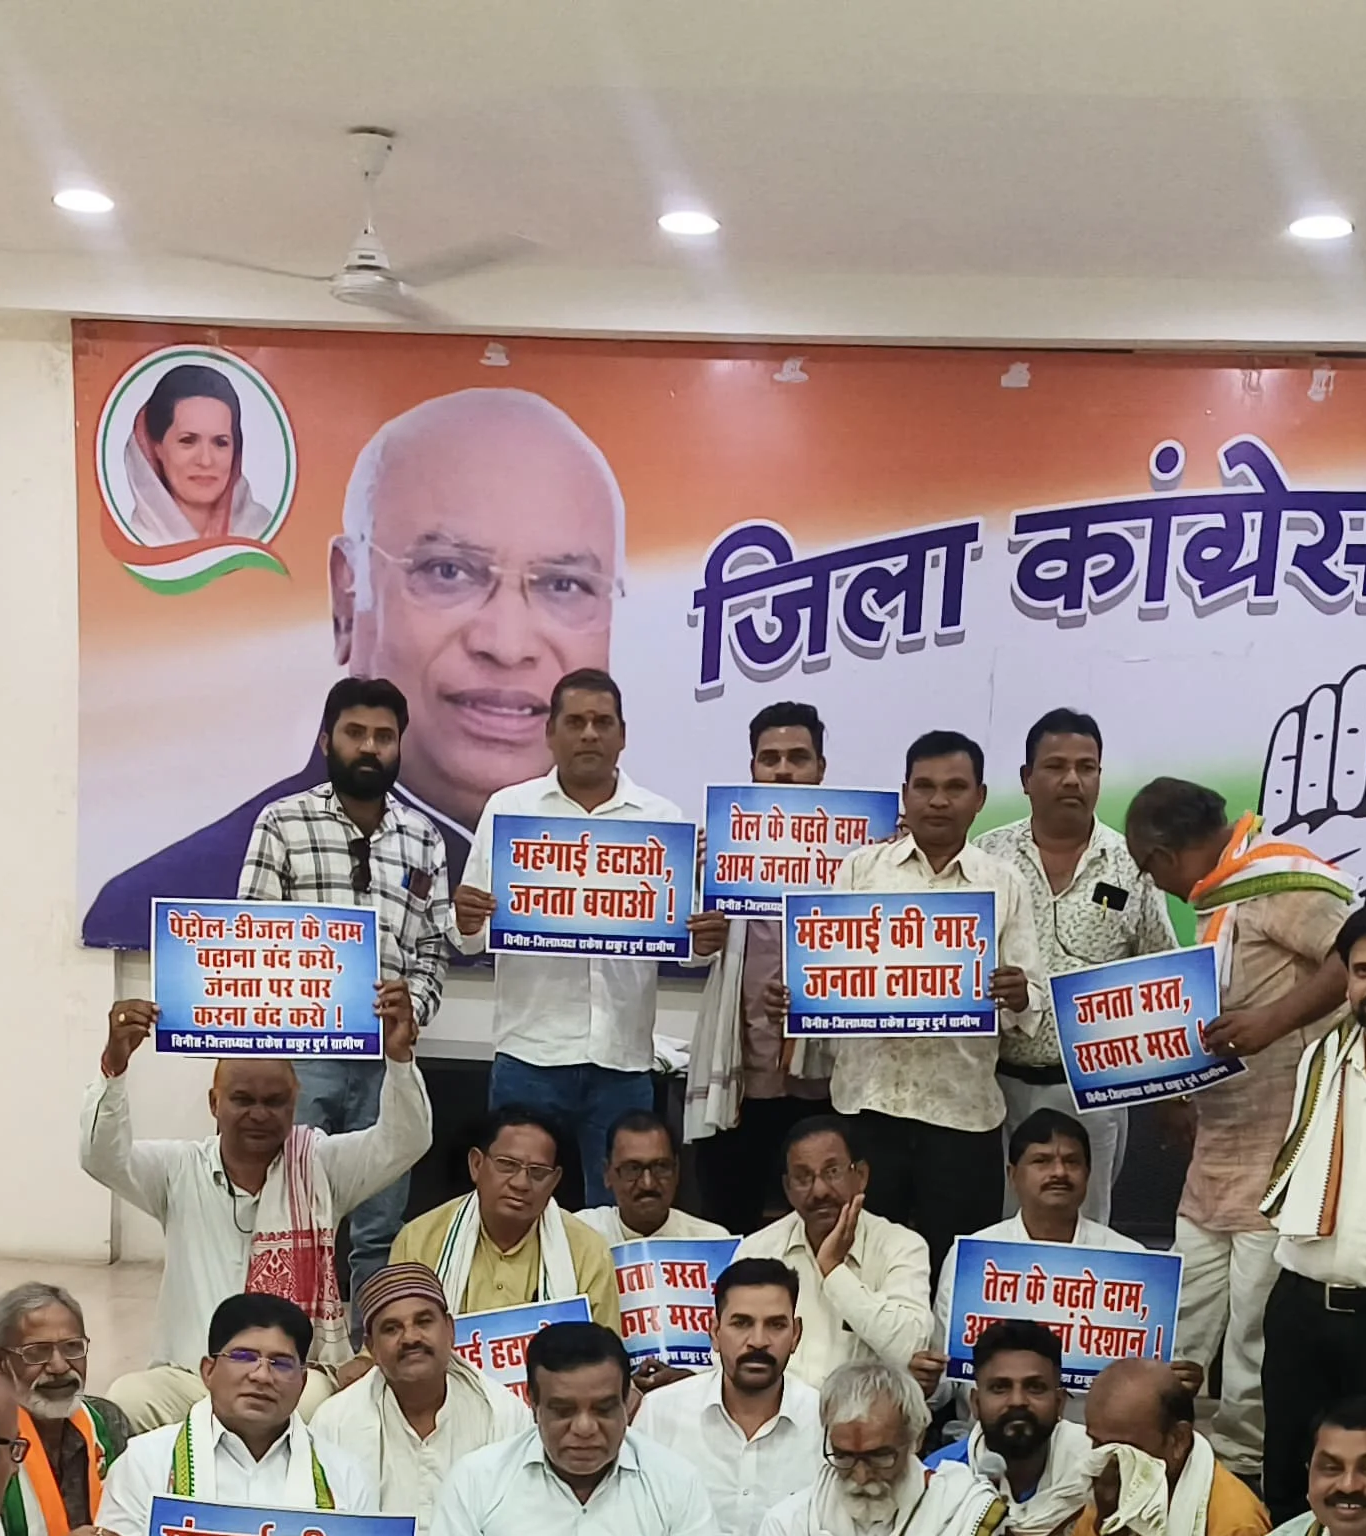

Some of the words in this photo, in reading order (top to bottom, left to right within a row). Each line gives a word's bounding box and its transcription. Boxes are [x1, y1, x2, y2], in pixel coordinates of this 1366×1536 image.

[690, 518, 981, 696] जिला
[731, 805, 762, 841] तेल
[768, 806, 784, 842] के
[512, 834, 589, 877] महंगाई
[596, 837, 672, 882] हटाओ,
[716, 855, 755, 882] आम
[509, 884, 576, 916] जनता
[301, 915, 321, 940] के
[327, 921, 363, 943] दाम
[890, 907, 925, 949] की
[933, 915, 987, 955] मार,
[263, 944, 291, 969] बंद
[299, 945, 342, 973] करो,
[269, 978, 294, 998] पर
[301, 979, 332, 999] वार
[804, 965, 877, 998] जनता
[885, 964, 962, 997] लाचार
[193, 1006, 246, 1026] करना
[253, 1002, 281, 1027] बंद
[289, 1002, 326, 1027] करो
[1074, 986, 1134, 1023] जनता
[1139, 977, 1191, 1015] त्रस्त,
[1074, 1035, 1143, 1073] सरकार
[1144, 1027, 1192, 1060] मस्त
[985, 1261, 1020, 1303] तेल
[1025, 1264, 1046, 1305] के
[1103, 1279, 1148, 1321] दाम,
